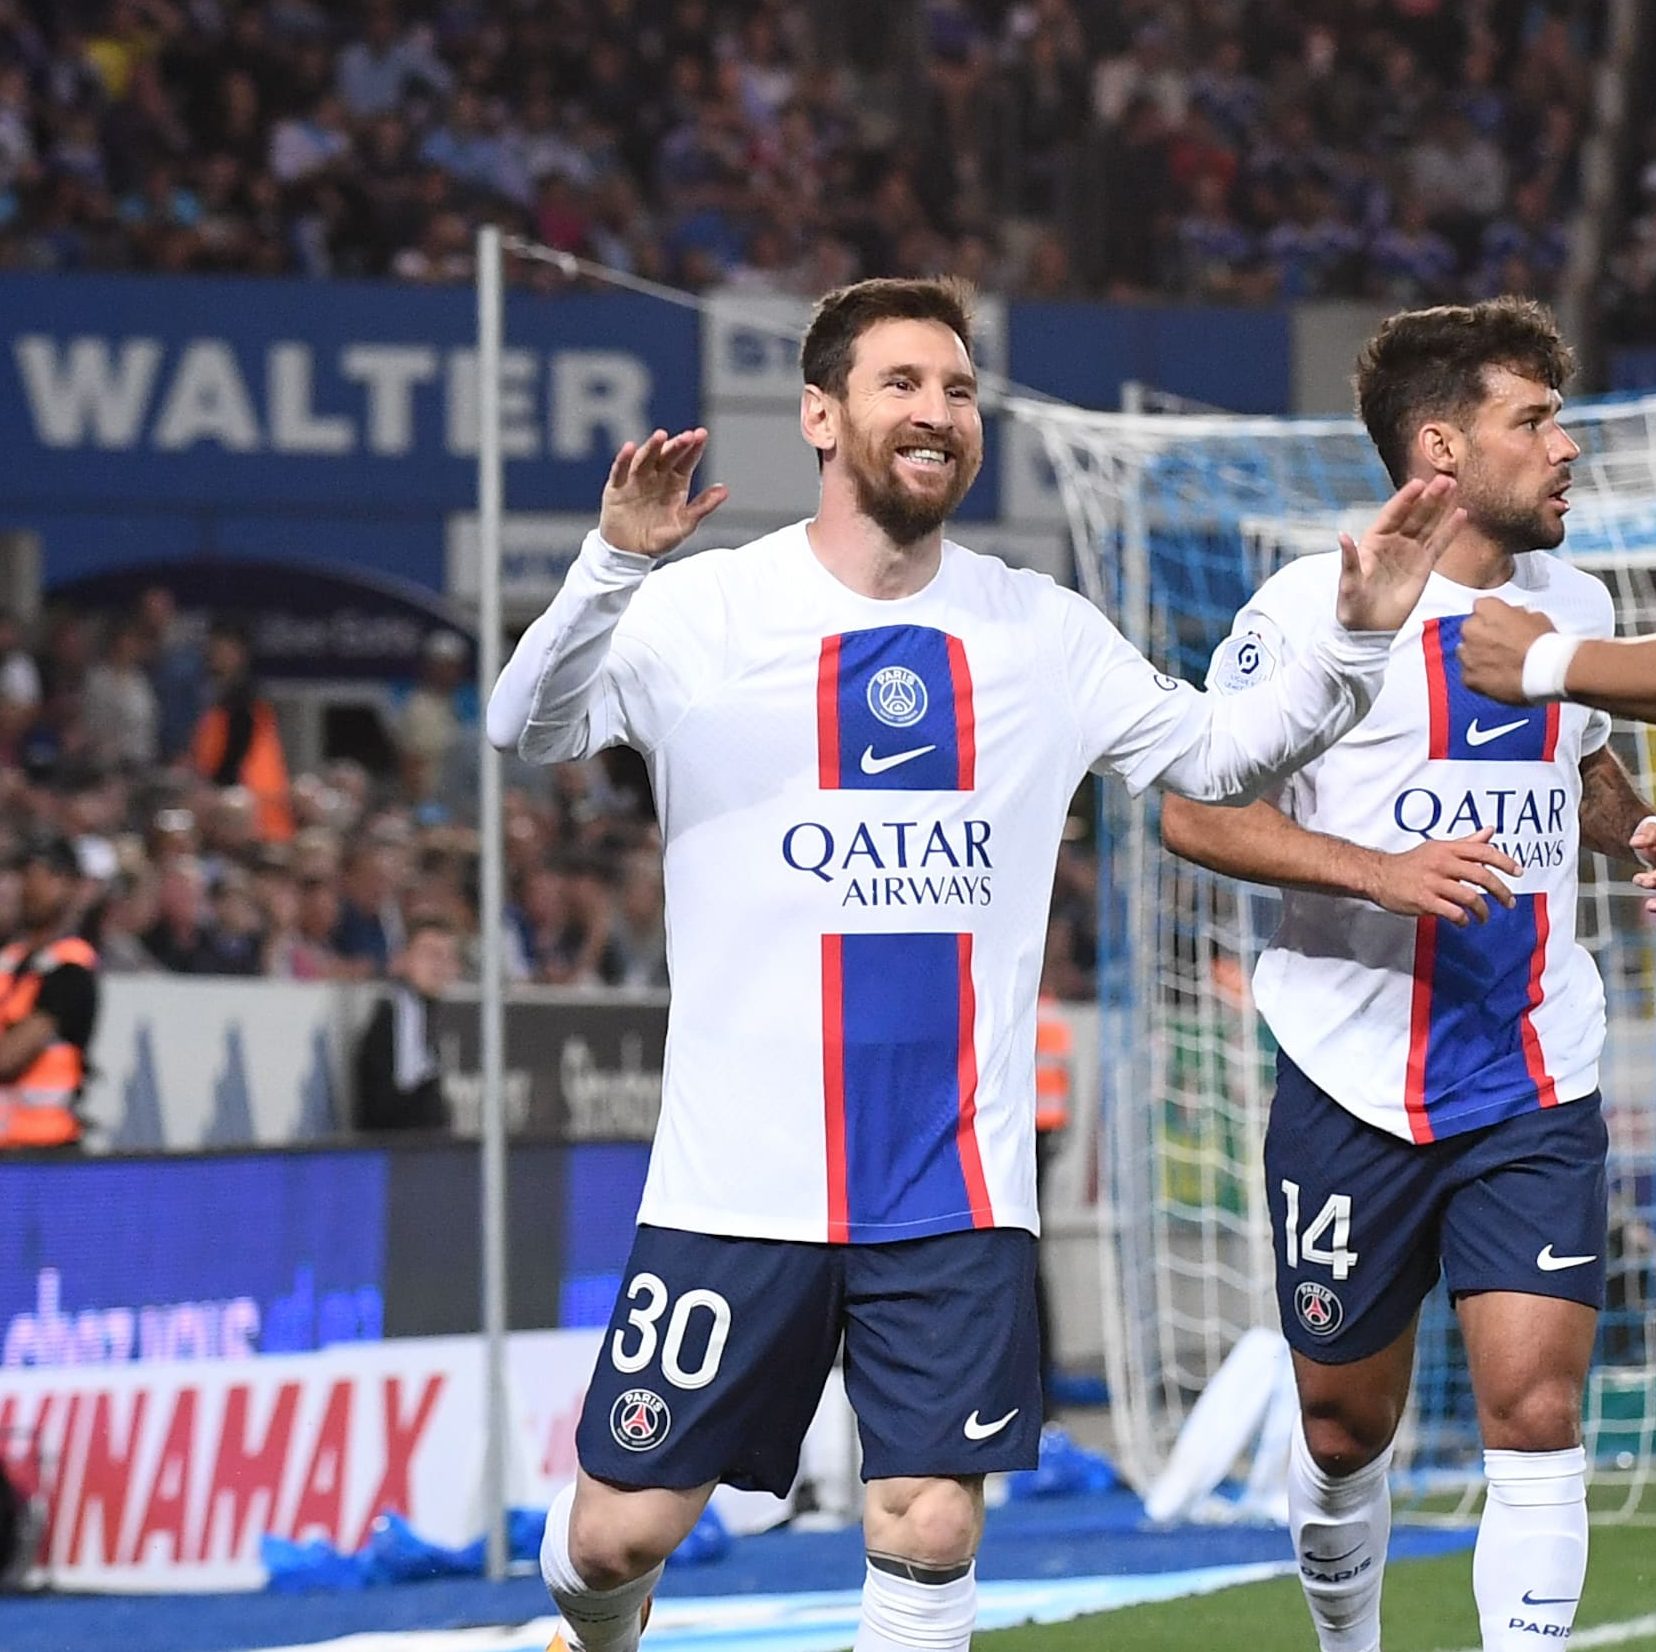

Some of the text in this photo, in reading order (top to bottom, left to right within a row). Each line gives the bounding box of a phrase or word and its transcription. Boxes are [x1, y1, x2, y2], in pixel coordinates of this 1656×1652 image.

[14, 334, 654, 460] WALTER
[876, 669, 918, 686] PARIS
[1394, 788, 1566, 841] QATAR
[782, 820, 993, 883] QATAR
[842, 876, 992, 907] AIRWAYS
[1281, 1179, 1359, 1281] 14
[612, 1272, 732, 1390] 30
[624, 1392, 663, 1413] PARIS
[1300, 1557, 1371, 1583] PARIS
